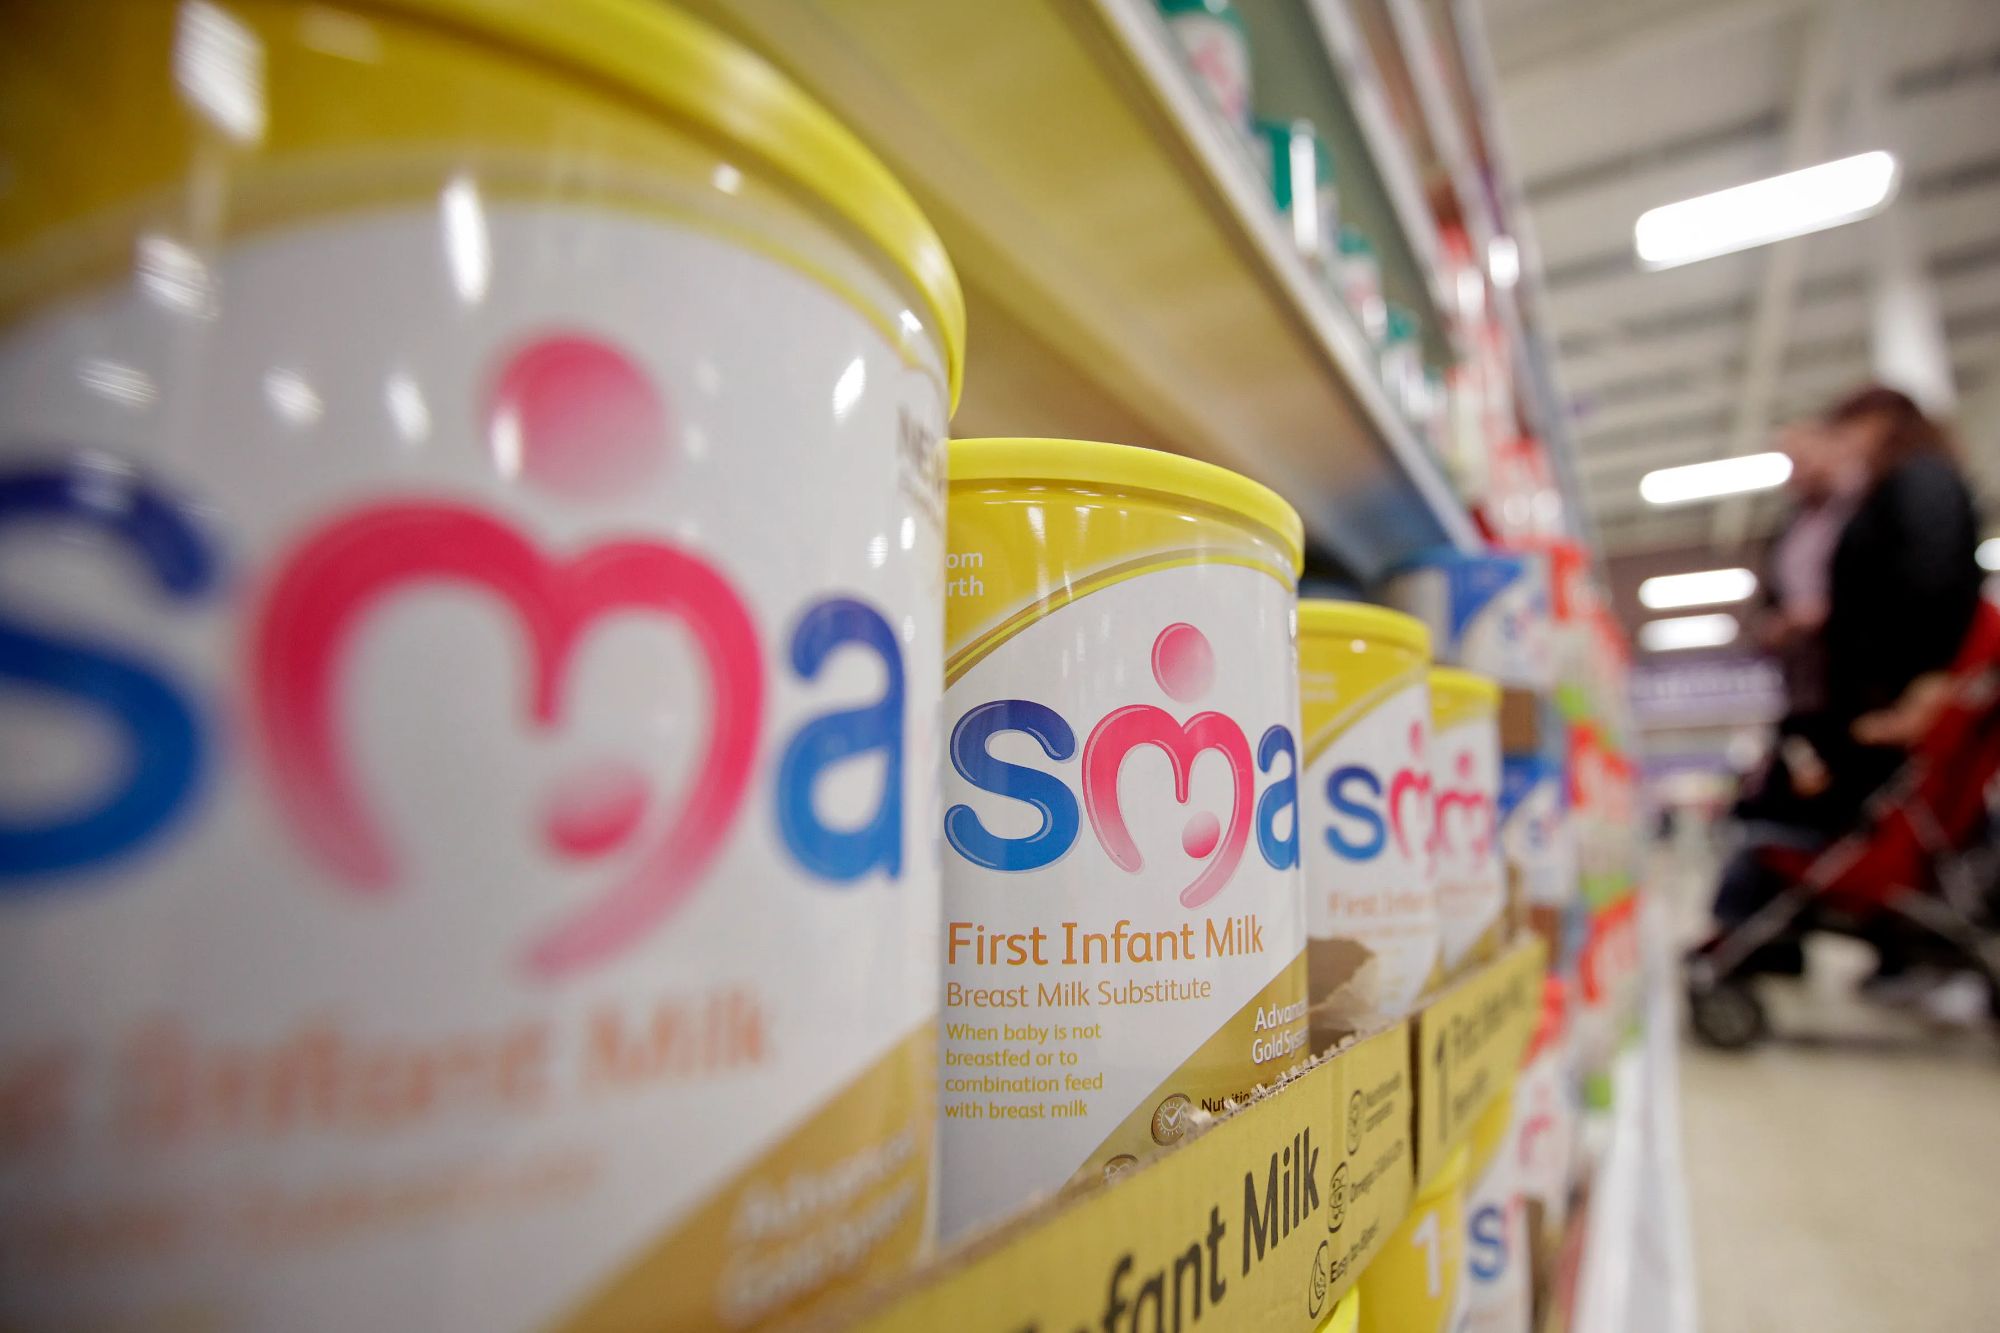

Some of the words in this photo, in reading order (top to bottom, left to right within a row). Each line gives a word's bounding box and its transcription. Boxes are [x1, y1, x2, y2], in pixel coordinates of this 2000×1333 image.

[948, 922, 1049, 966] First
[1061, 920, 1196, 965] Infant
[1205, 914, 1264, 958] Milk
[946, 981, 1030, 1008] Breast
[1037, 981, 1091, 1008] Milk
[1097, 977, 1213, 1006] Substitute
[946, 1024, 999, 1041] When
[1004, 1023, 1049, 1045] baby
[1054, 1024, 1068, 1040] is
[1073, 1023, 1102, 1040] not
[945, 1048, 1030, 1067] breastfed
[1035, 1053, 1054, 1067] or
[1059, 1050, 1078, 1065] to
[945, 1074, 1060, 1093] combination
[1065, 1071, 1103, 1091] feed
[944, 1100, 983, 1119] with
[989, 1101, 1046, 1119] breast
[1051, 1099, 1089, 1118] milk
[1241, 1126, 1320, 1278] Milk
